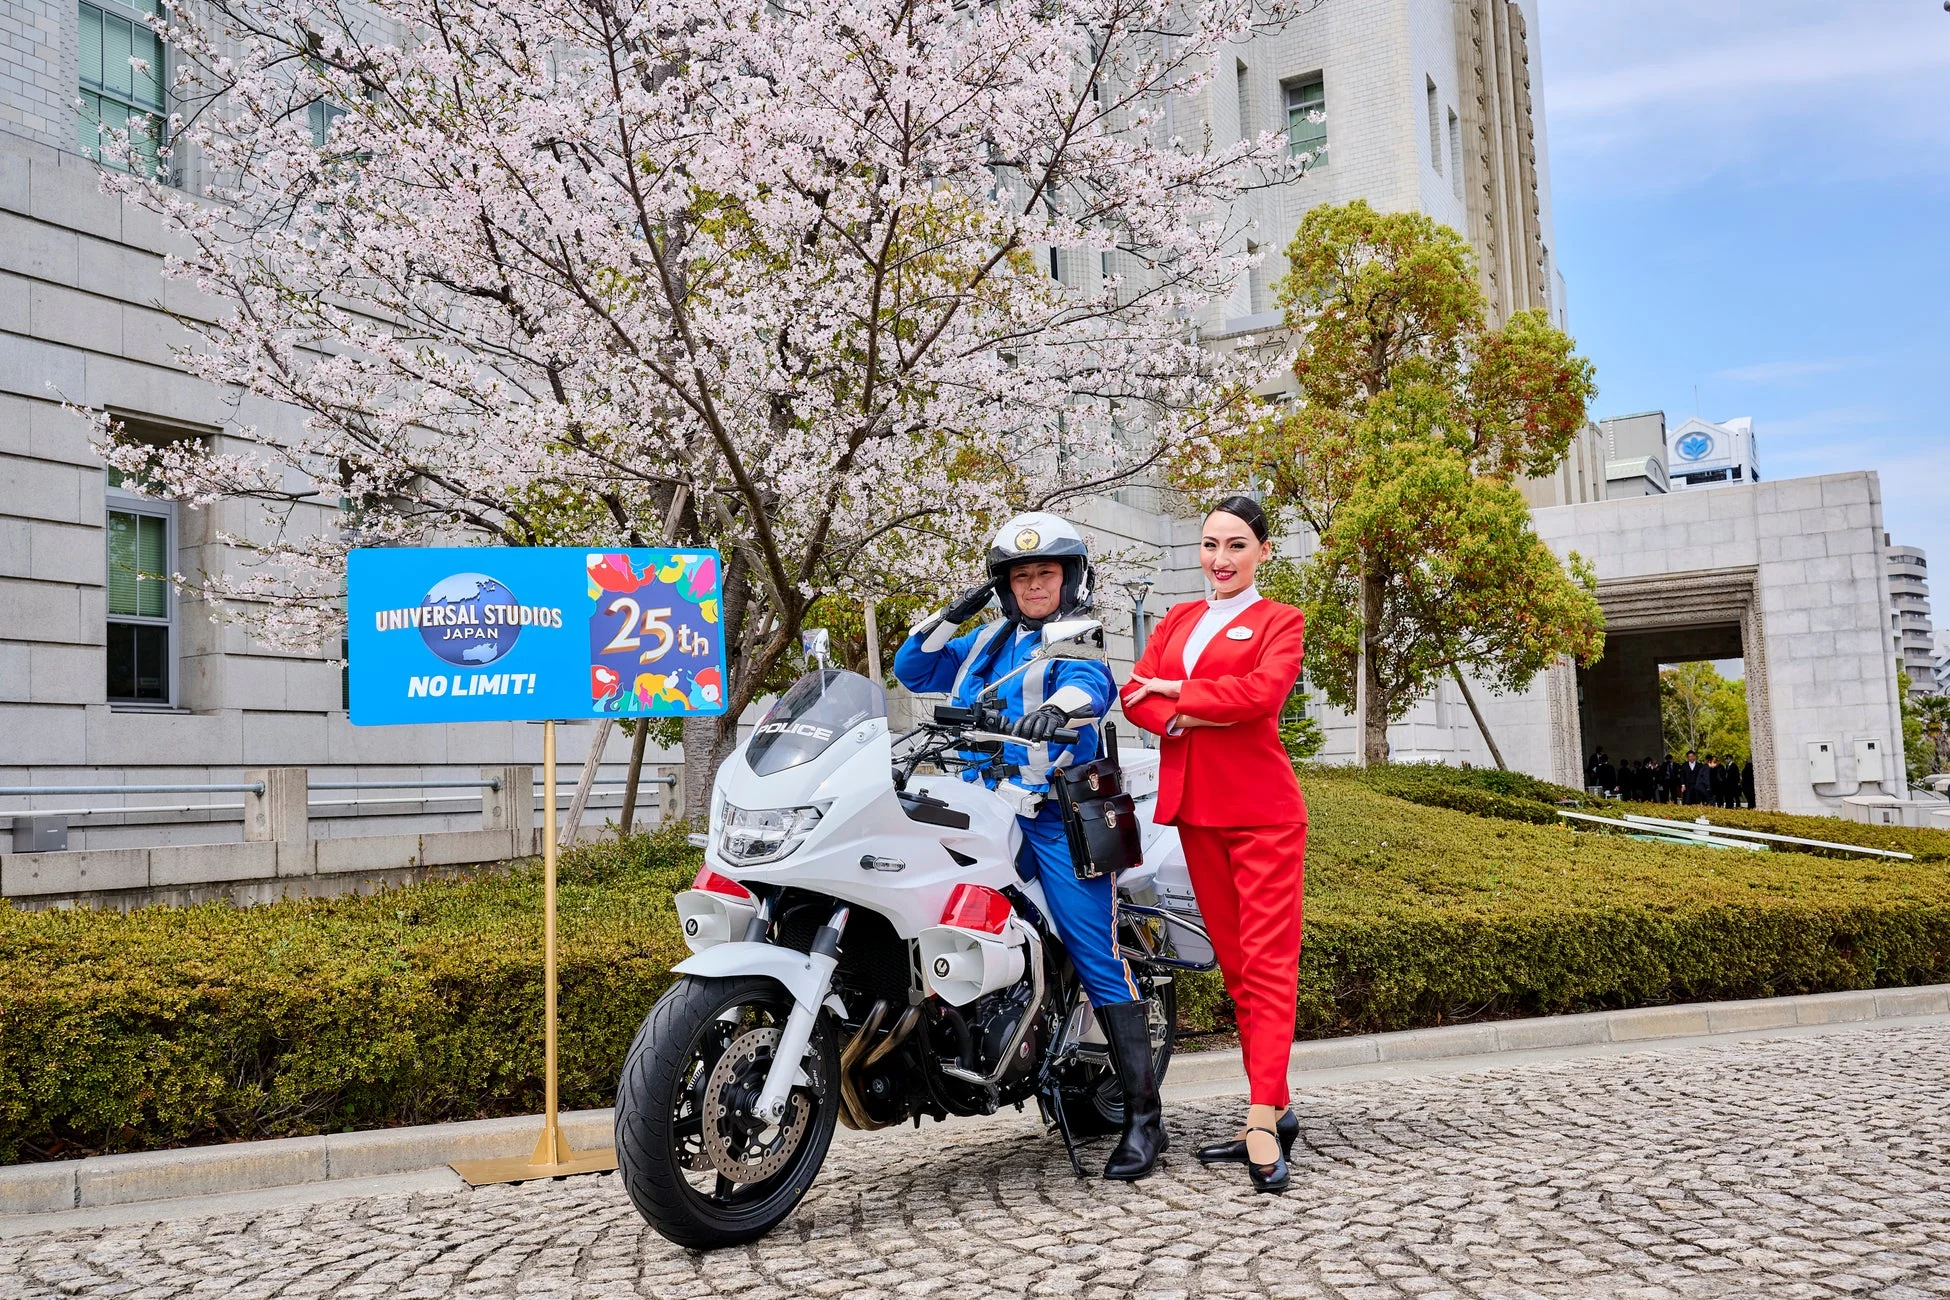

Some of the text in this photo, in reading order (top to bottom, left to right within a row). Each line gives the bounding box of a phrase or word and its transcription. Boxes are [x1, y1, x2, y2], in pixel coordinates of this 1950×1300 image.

[375, 603, 564, 632] UNIVERSAL STUDIOS
[443, 627, 499, 640] JAPAN
[600, 597, 709, 665] 25th
[407, 673, 537, 698] NO LIMIT!
[755, 722, 834, 742] POLICE
